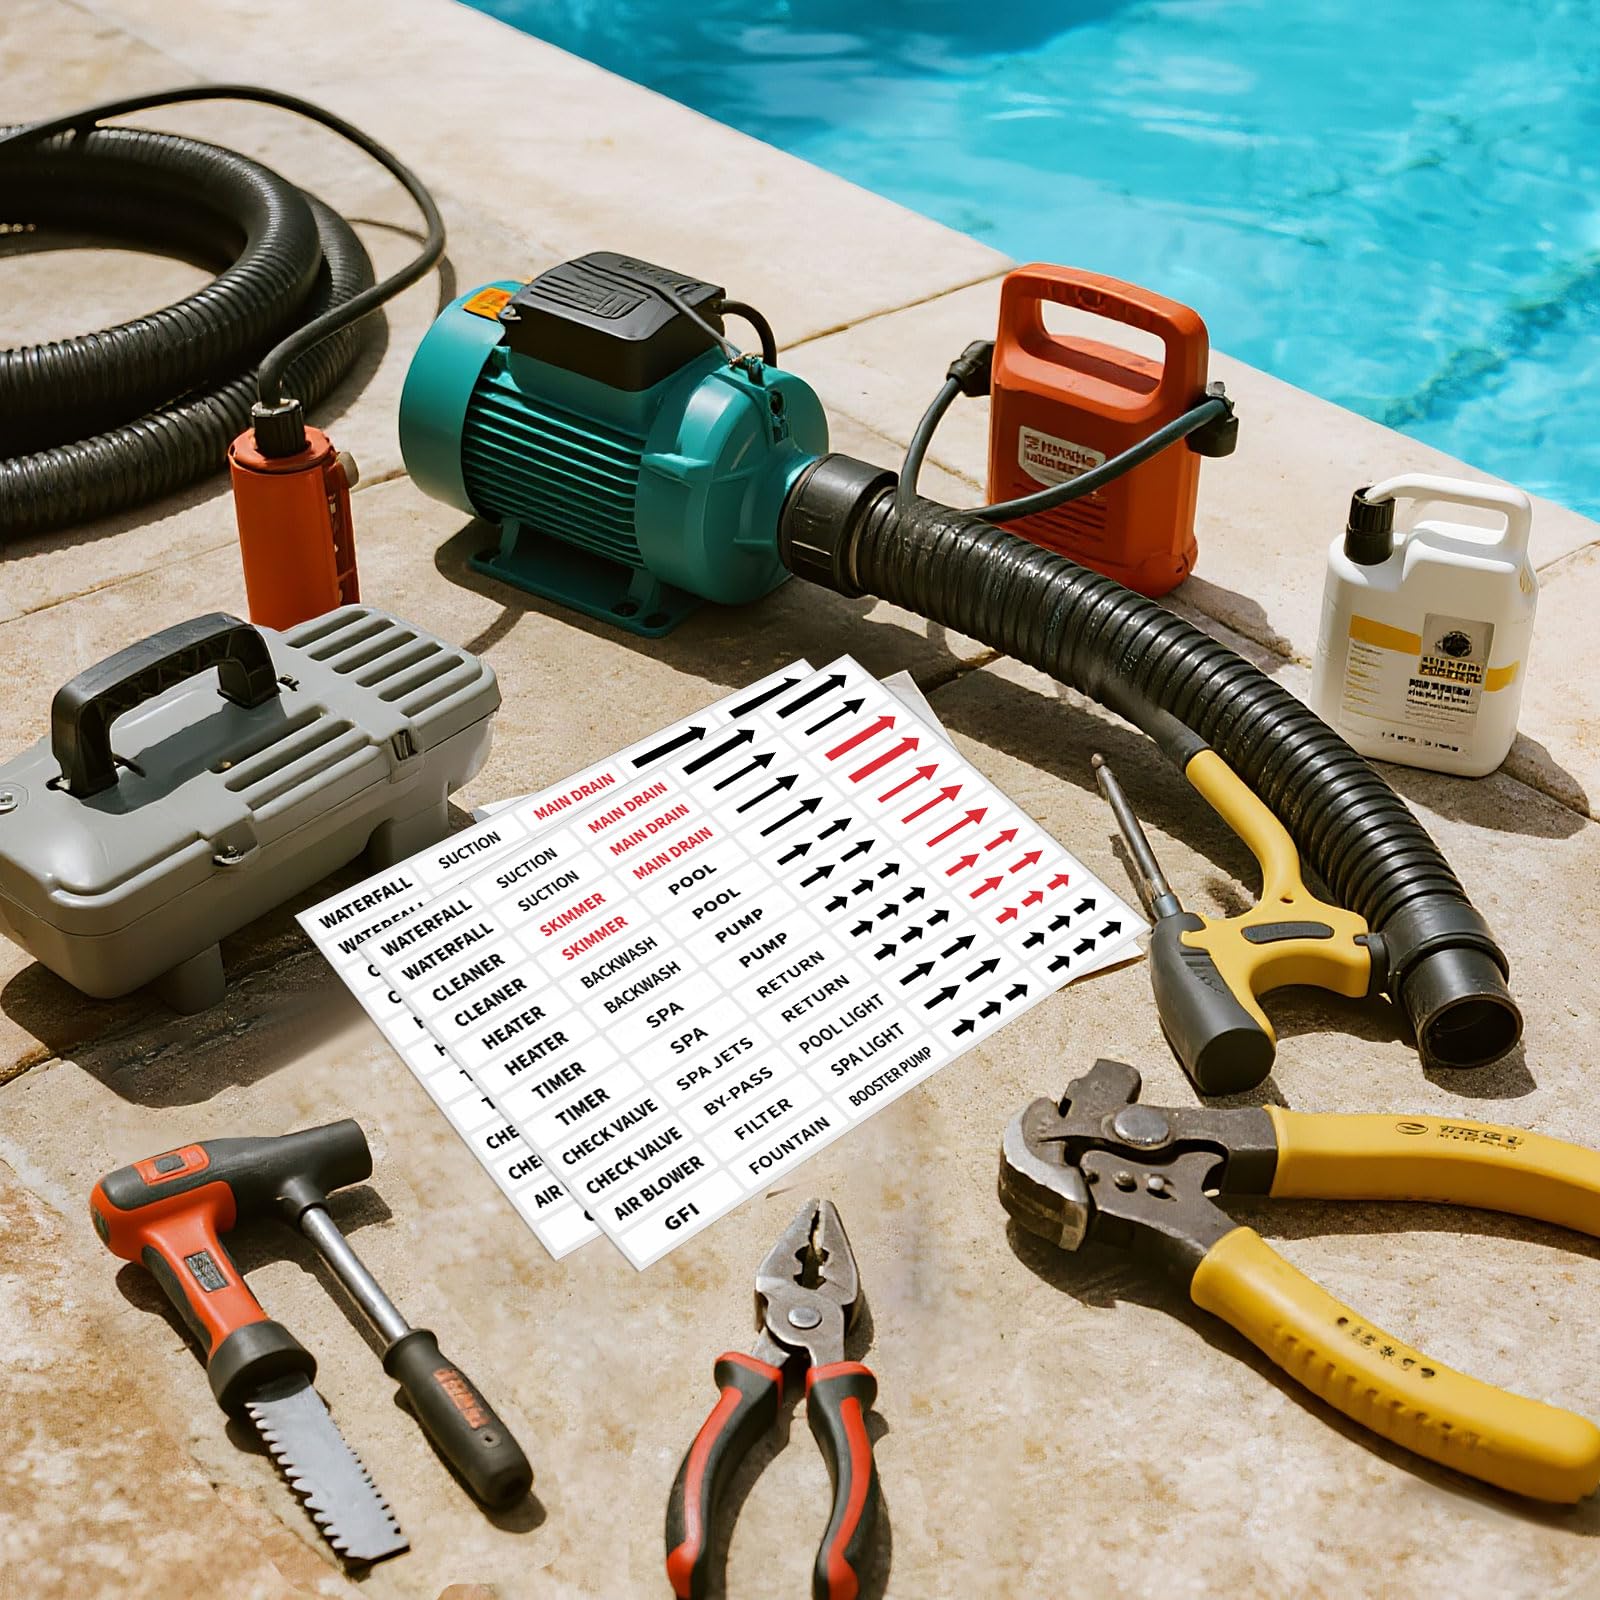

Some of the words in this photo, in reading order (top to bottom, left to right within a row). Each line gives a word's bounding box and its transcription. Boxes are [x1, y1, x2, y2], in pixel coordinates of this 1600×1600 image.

[534, 795, 572, 820] MAIN
[570, 773, 615, 801] DRAIN
[588, 807, 626, 833] MAIN
[624, 782, 667, 812] DRAIN
[439, 831, 501, 869] SUCTION
[610, 829, 648, 856] MAIN
[645, 804, 689, 834] DRAIN
[633, 853, 671, 880] MAIN
[668, 827, 713, 858] DRAIN
[496, 848, 558, 888] SUCTION
[518, 870, 579, 911] SUCTION
[668, 865, 717, 895] POOL
[319, 878, 413, 928] WATERFALL
[540, 893, 606, 936] SKIMMER
[692, 889, 741, 919] POOL
[715, 909, 763, 943] PUMP
[381, 900, 472, 956] WATERFALL
[401, 923, 494, 980] WATERFALL
[562, 916, 628, 960] SKIMMER
[739, 933, 787, 968] PUMP
[433, 954, 505, 1001] CLEANER
[580, 937, 658, 988] BACKWASH
[756, 951, 825, 998] RETURN
[455, 978, 527, 1026] CLEANER
[604, 961, 681, 1014] BACKWASH
[781, 975, 850, 1022] RETURN
[482, 1006, 546, 1050] HEATER
[646, 1002, 684, 1028] SPA
[799, 1024, 843, 1054] POOL
[839, 993, 883, 1027] LIGHT
[504, 1032, 569, 1076] HEATER
[670, 1028, 708, 1054] SPA
[677, 1066, 712, 1091] SPA
[714, 1038, 753, 1069] JETS
[831, 1053, 863, 1076] SPA
[859, 1022, 904, 1057] LIGHT
[531, 1062, 586, 1098] TIMER
[704, 1067, 773, 1115] BY-PASS
[849, 1068, 903, 1106] BOOSTER
[898, 1047, 931, 1073] PUMP
[555, 1088, 610, 1125] TIMER
[734, 1099, 793, 1140] FILTER
[486, 1125, 520, 1149] CHE
[563, 1127, 615, 1165] CHECK
[610, 1099, 658, 1132] VALVE
[749, 1117, 830, 1175] FOUNTAIN
[509, 1155, 544, 1179] CHE
[587, 1155, 639, 1193] CHECK
[634, 1127, 682, 1161] VALVE
[534, 1185, 564, 1208] AIR
[614, 1197, 643, 1221] AIR
[639, 1156, 704, 1202] BLOWER
[665, 1203, 700, 1230] GFI
